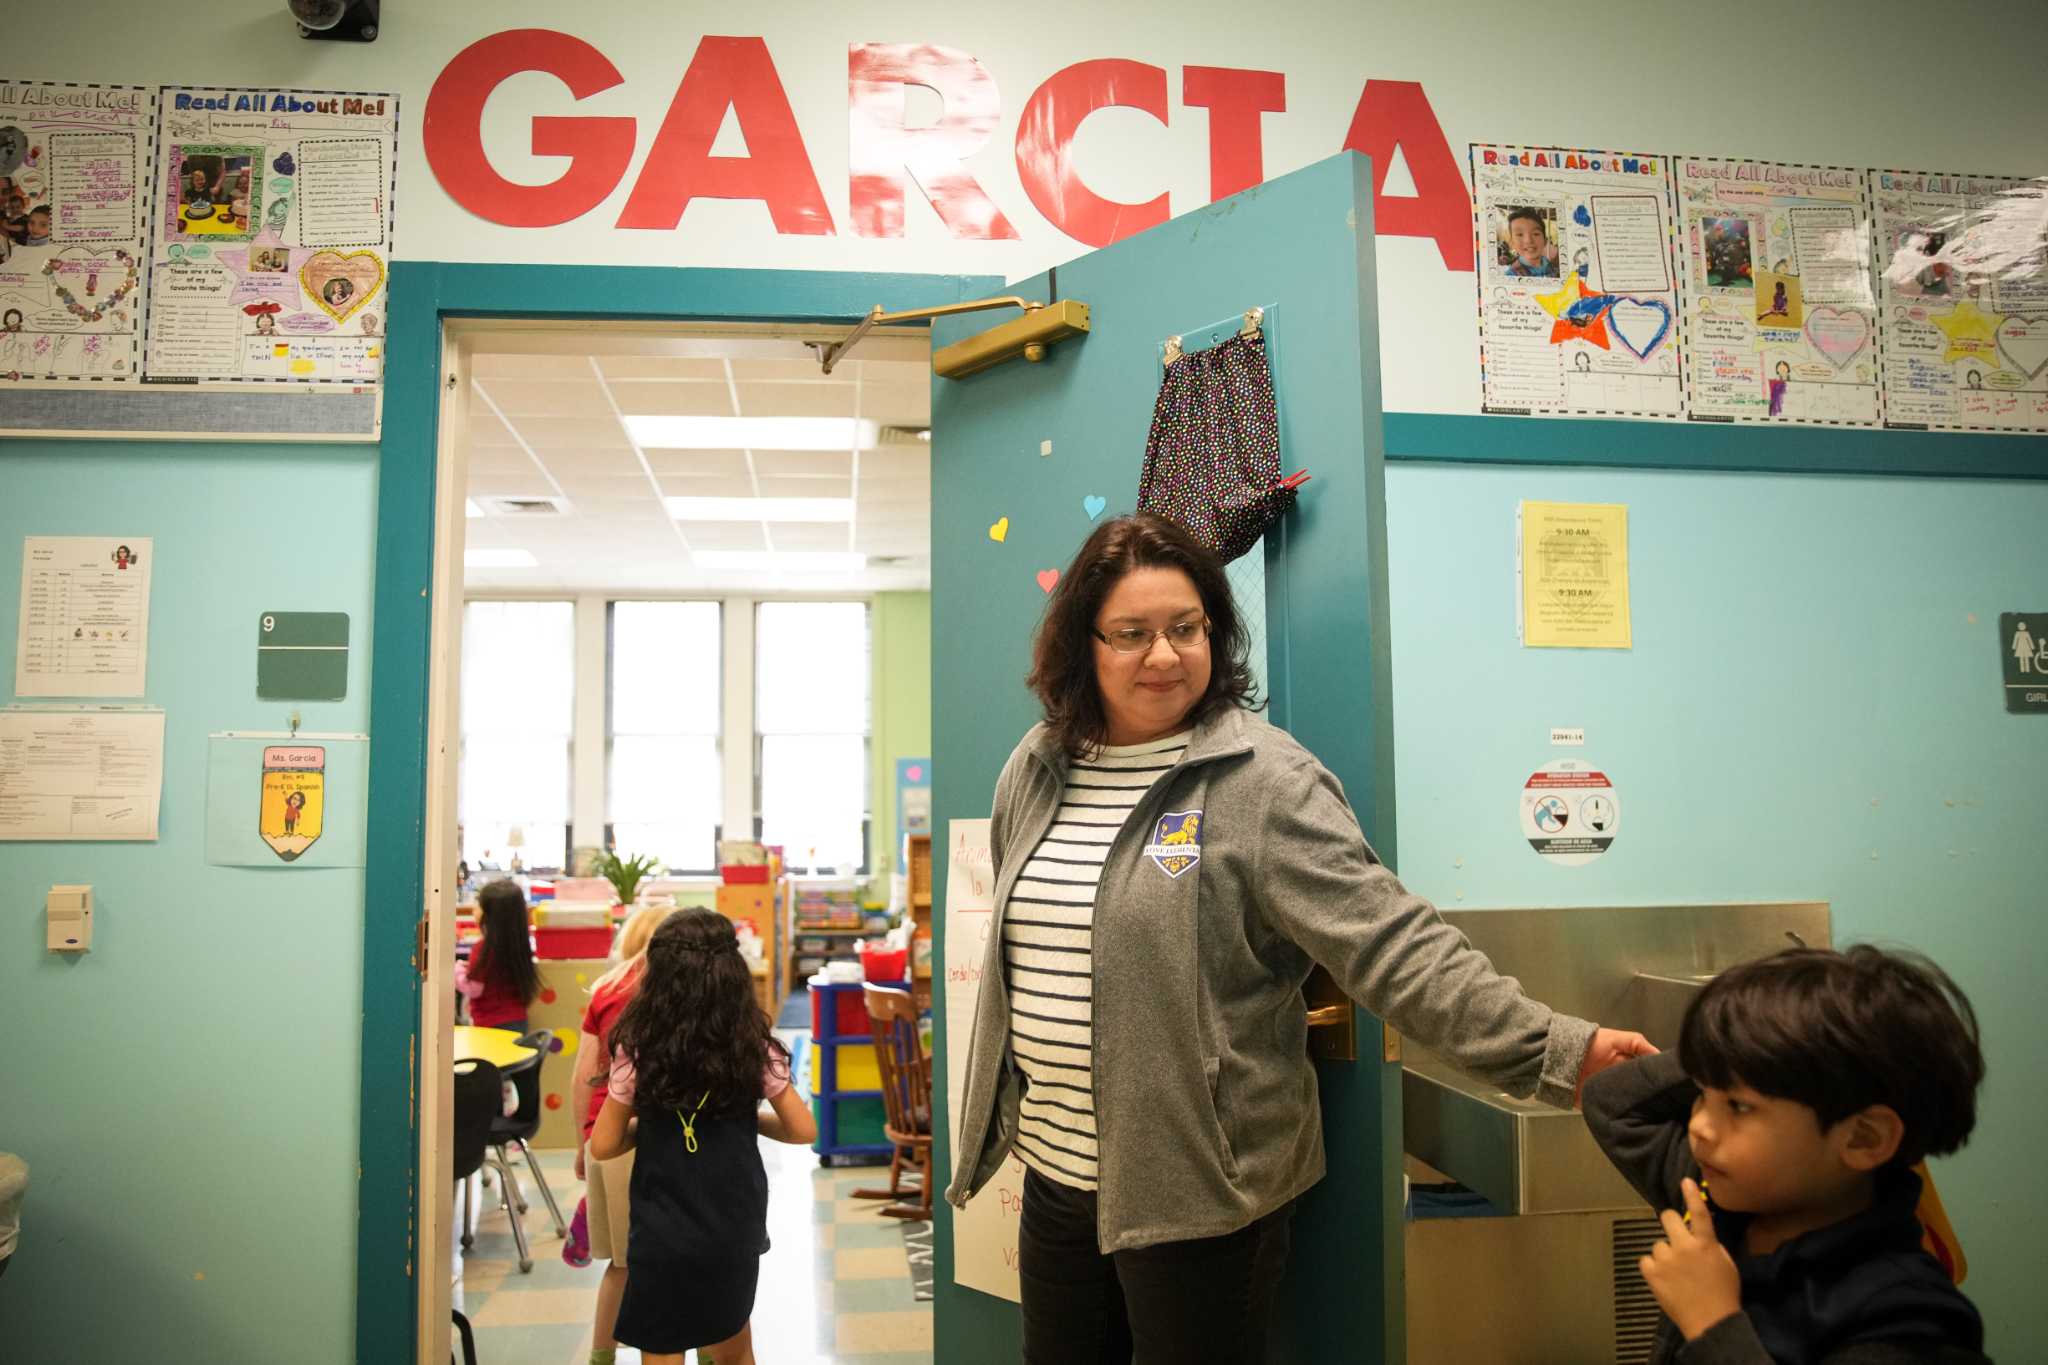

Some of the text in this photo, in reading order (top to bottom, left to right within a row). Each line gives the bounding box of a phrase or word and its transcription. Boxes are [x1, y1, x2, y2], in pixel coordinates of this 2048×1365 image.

[0, 86, 140, 110] ll About Me!
[175, 94, 384, 116] Read All About Me!
[423, 28, 1474, 271] GARCIA
[1484, 151, 1657, 176] Read All About Me!
[1686, 163, 1852, 188] Read All About Me!
[1880, 175, 1923, 192] Read
[1927, 177, 1951, 194] All
[1575, 528, 1590, 536] AM
[1578, 589, 1592, 597] AM
[263, 616, 275, 632] 9
[272, 754, 316, 762] Ms. Garcia
